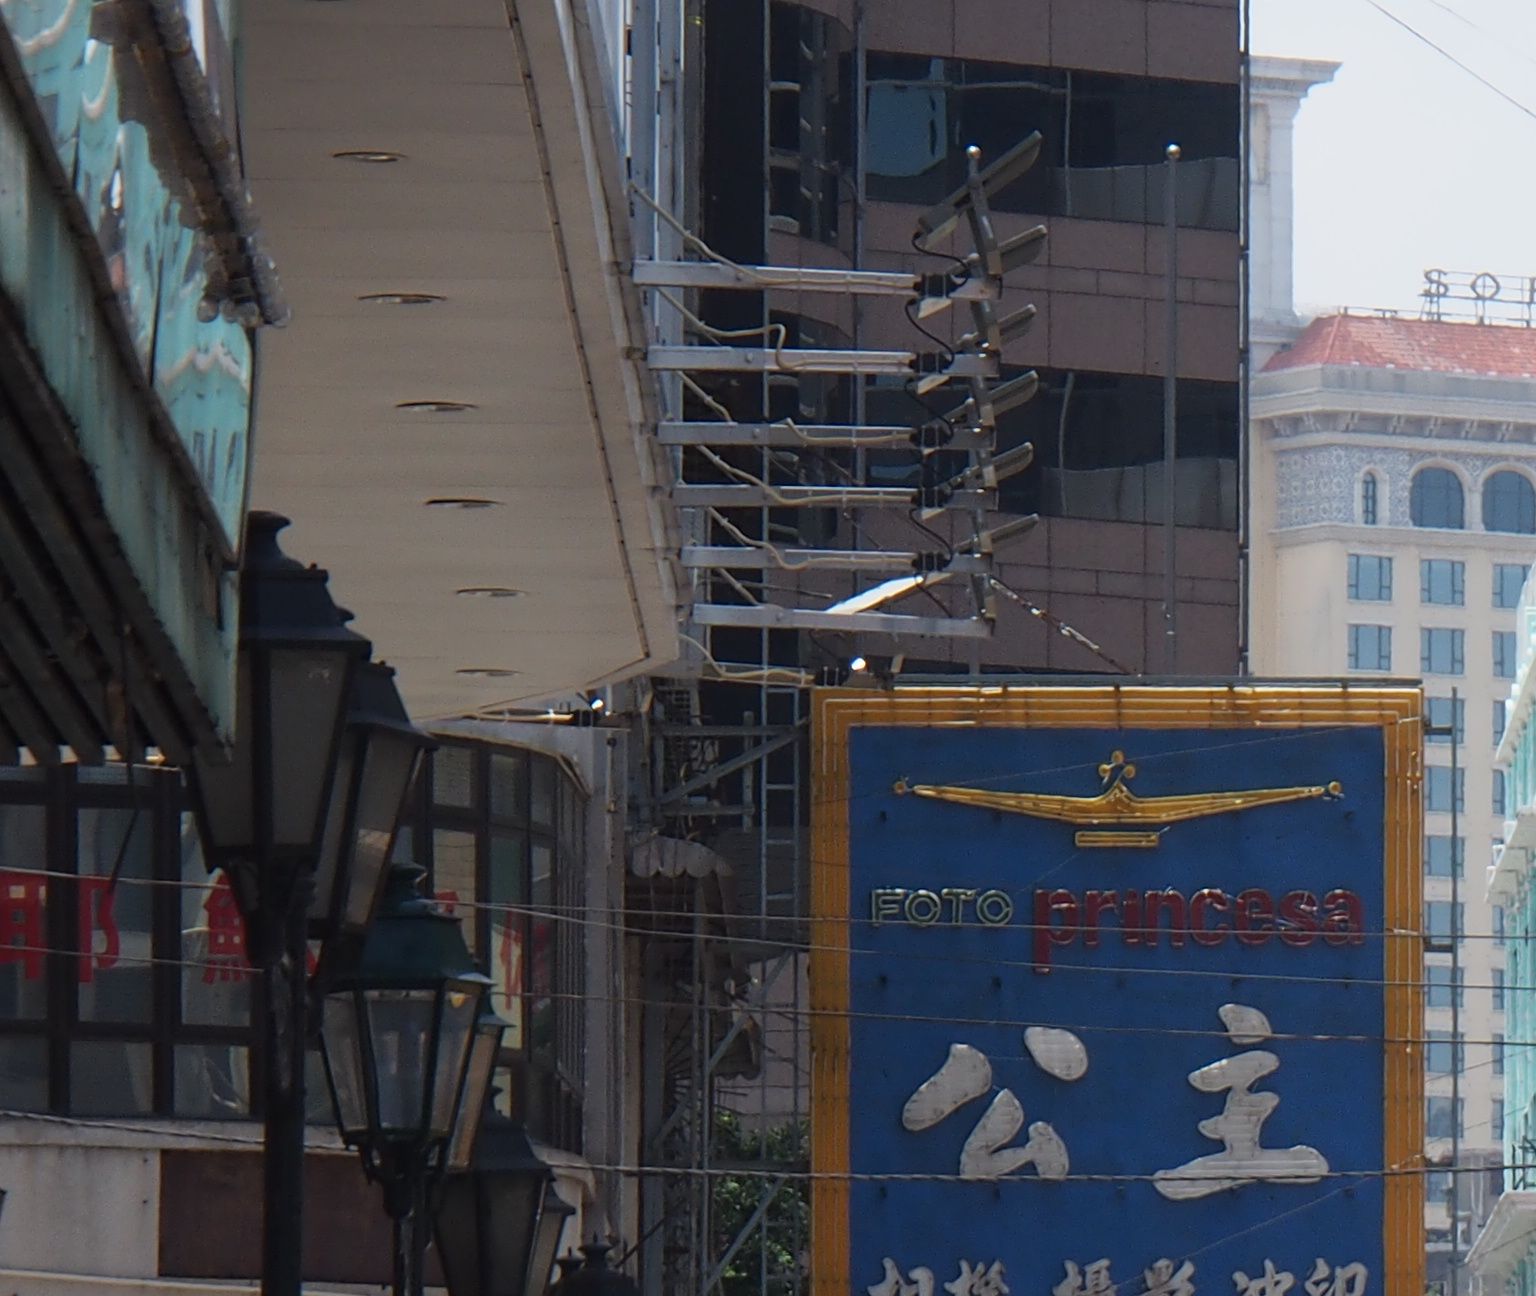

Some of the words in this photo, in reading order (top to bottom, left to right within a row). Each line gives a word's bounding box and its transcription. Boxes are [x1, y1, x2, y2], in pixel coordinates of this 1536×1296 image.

[871, 887, 1013, 927] FOTO
[1033, 885, 1366, 974] princesa
[902, 1003, 1330, 1201] 公主
